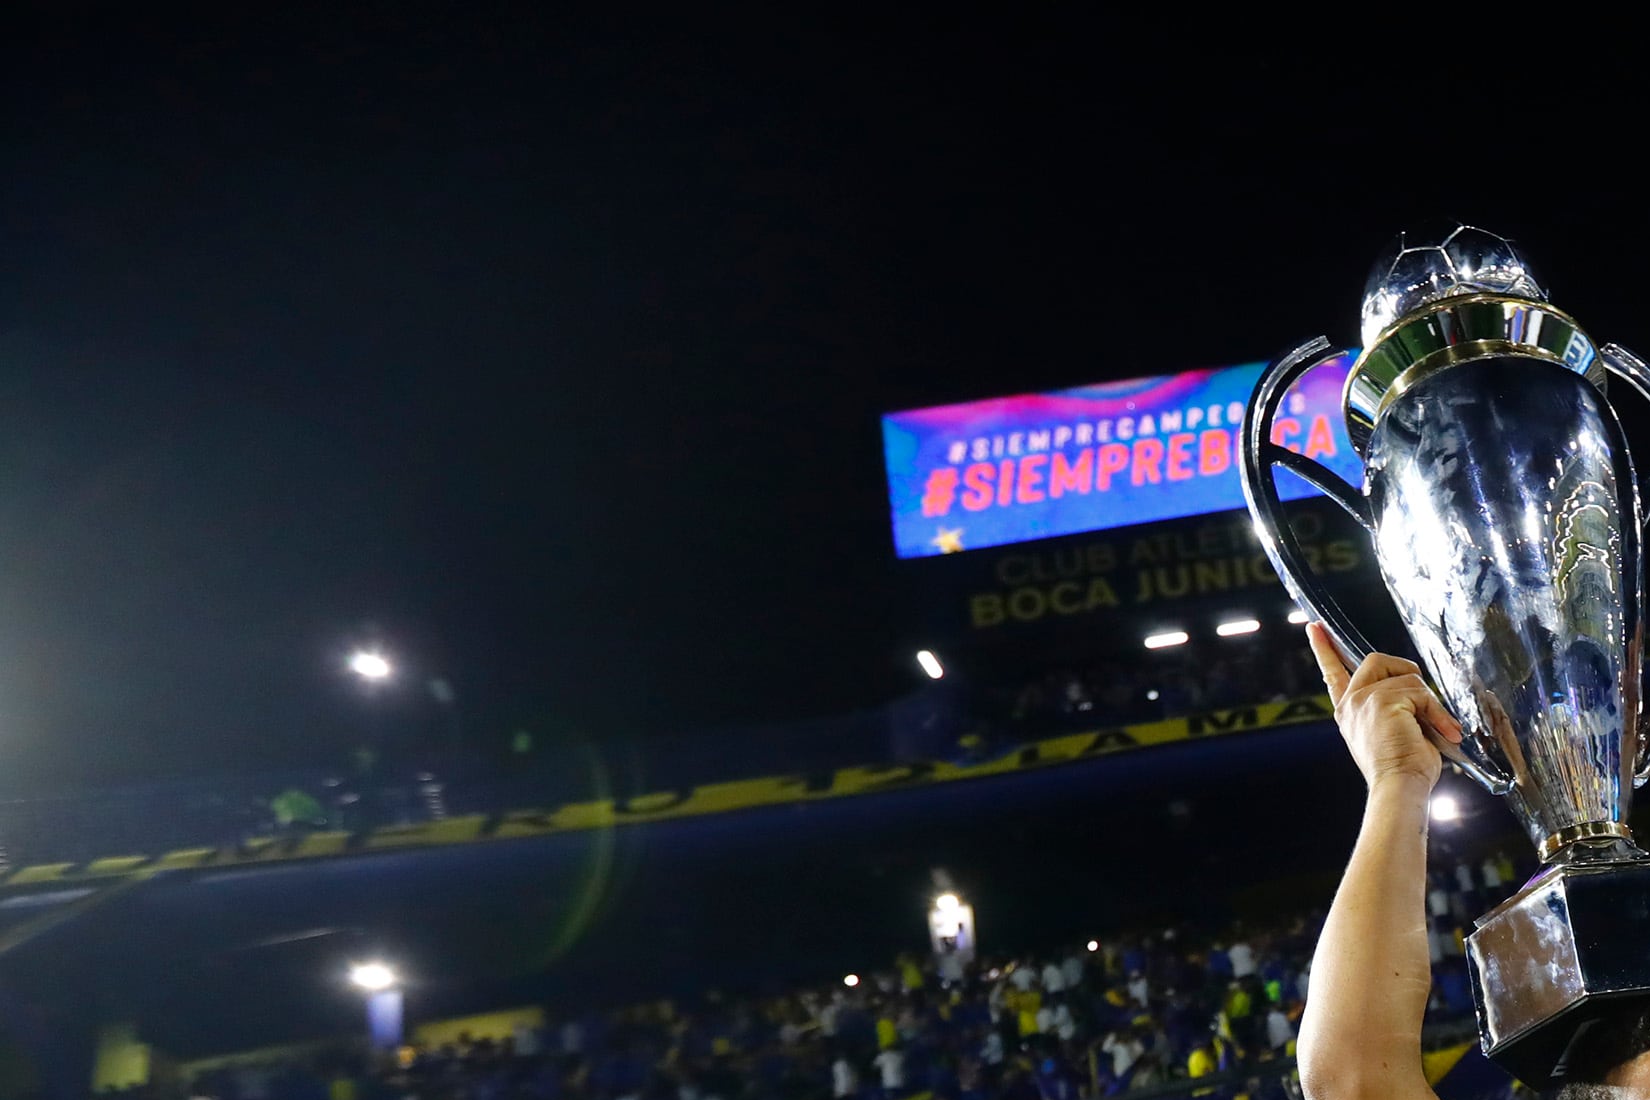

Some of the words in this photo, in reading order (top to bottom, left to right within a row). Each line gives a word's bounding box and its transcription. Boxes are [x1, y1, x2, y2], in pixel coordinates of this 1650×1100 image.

[948, 392, 1305, 464] #SIEMPRECAMPEOS
[921, 414, 1337, 517] #SIEMPREBCA
[996, 542, 1117, 587] CLUB
[1130, 511, 1322, 566] ATLEO
[970, 576, 1120, 628] BOCA
